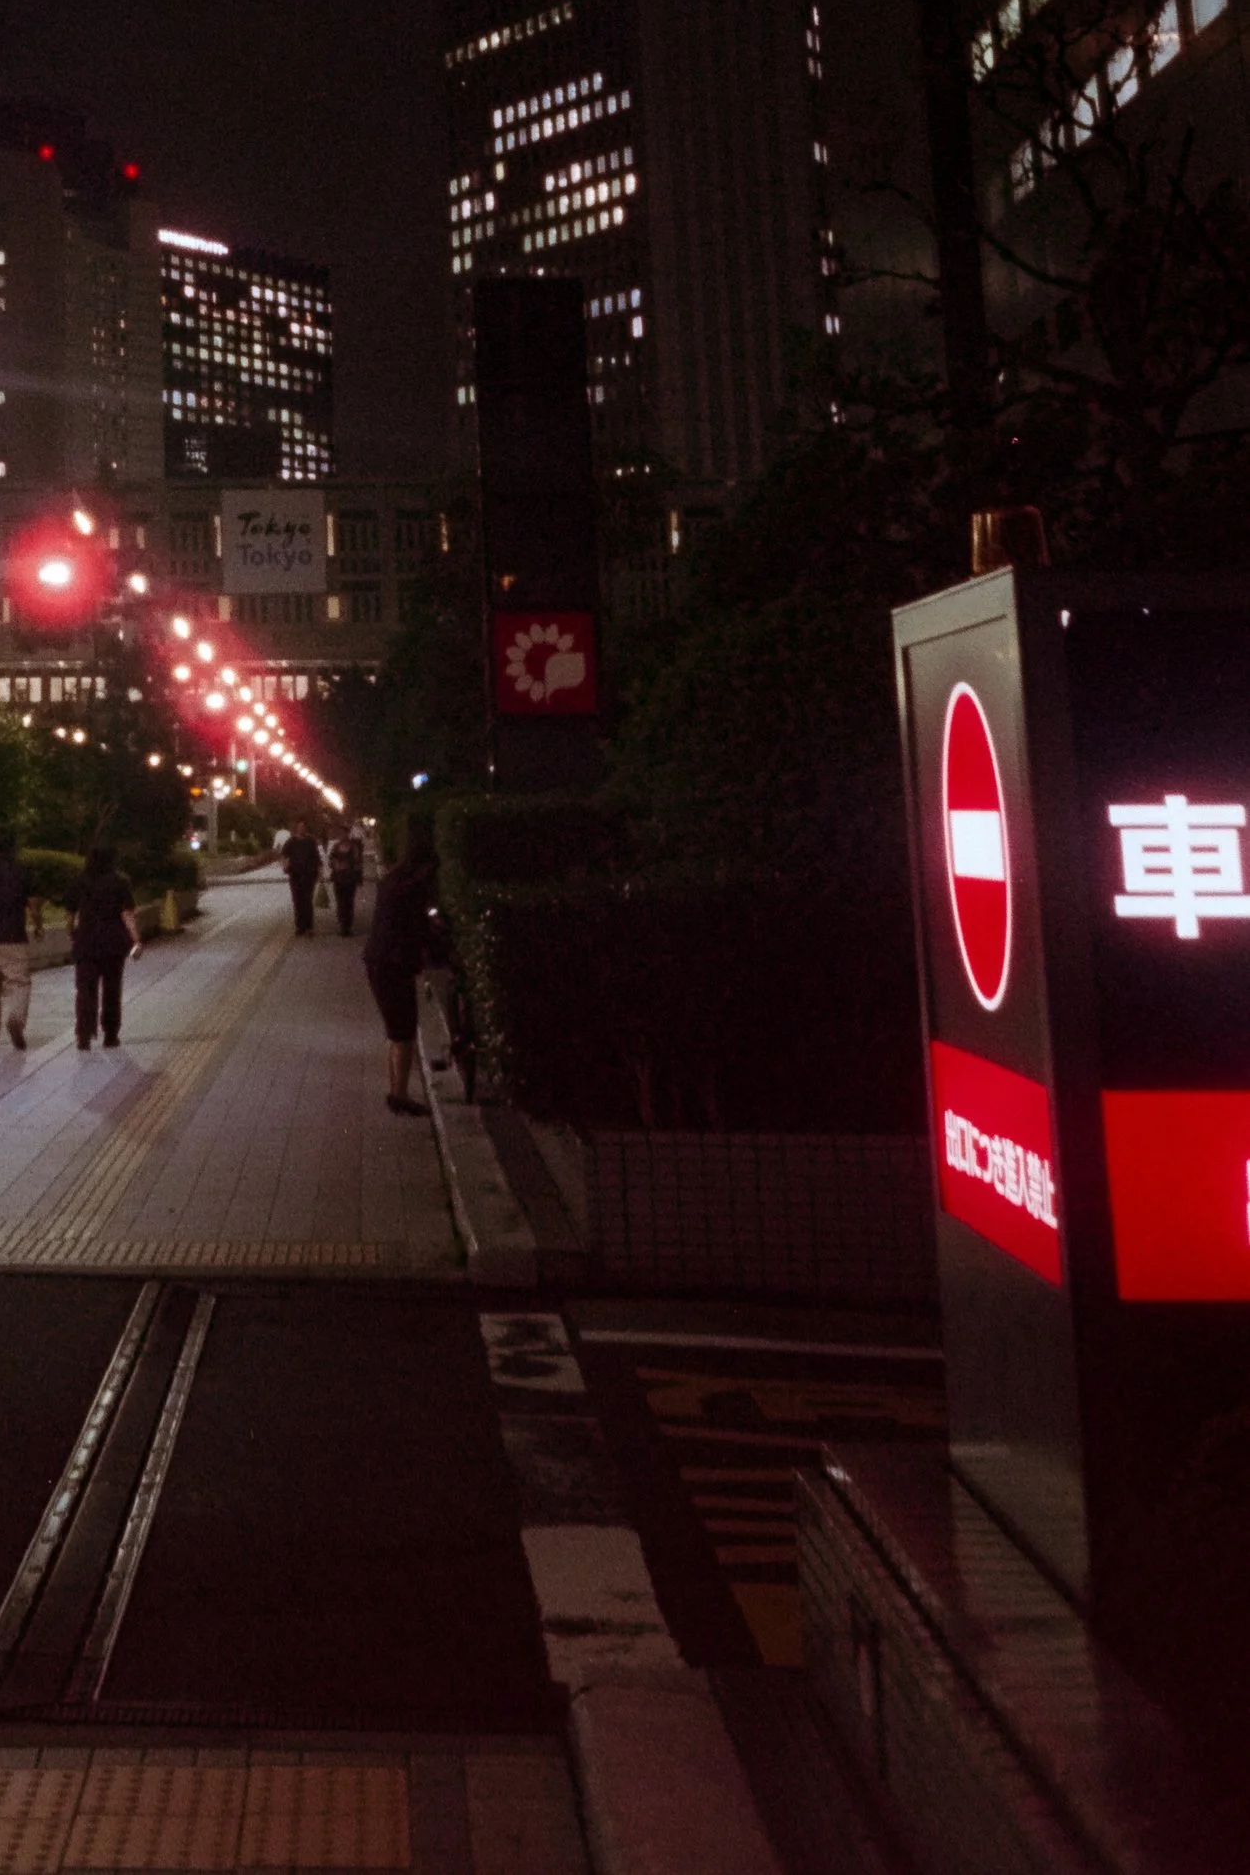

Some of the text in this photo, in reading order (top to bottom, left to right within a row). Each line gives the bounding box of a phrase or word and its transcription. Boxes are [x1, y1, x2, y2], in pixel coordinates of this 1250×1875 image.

[237, 511, 312, 549] Tokyo
[237, 543, 313, 571] Tokyo
[1108, 794, 1250, 939] 車
[944, 1108, 1059, 1230] 出口につき進入禁止
